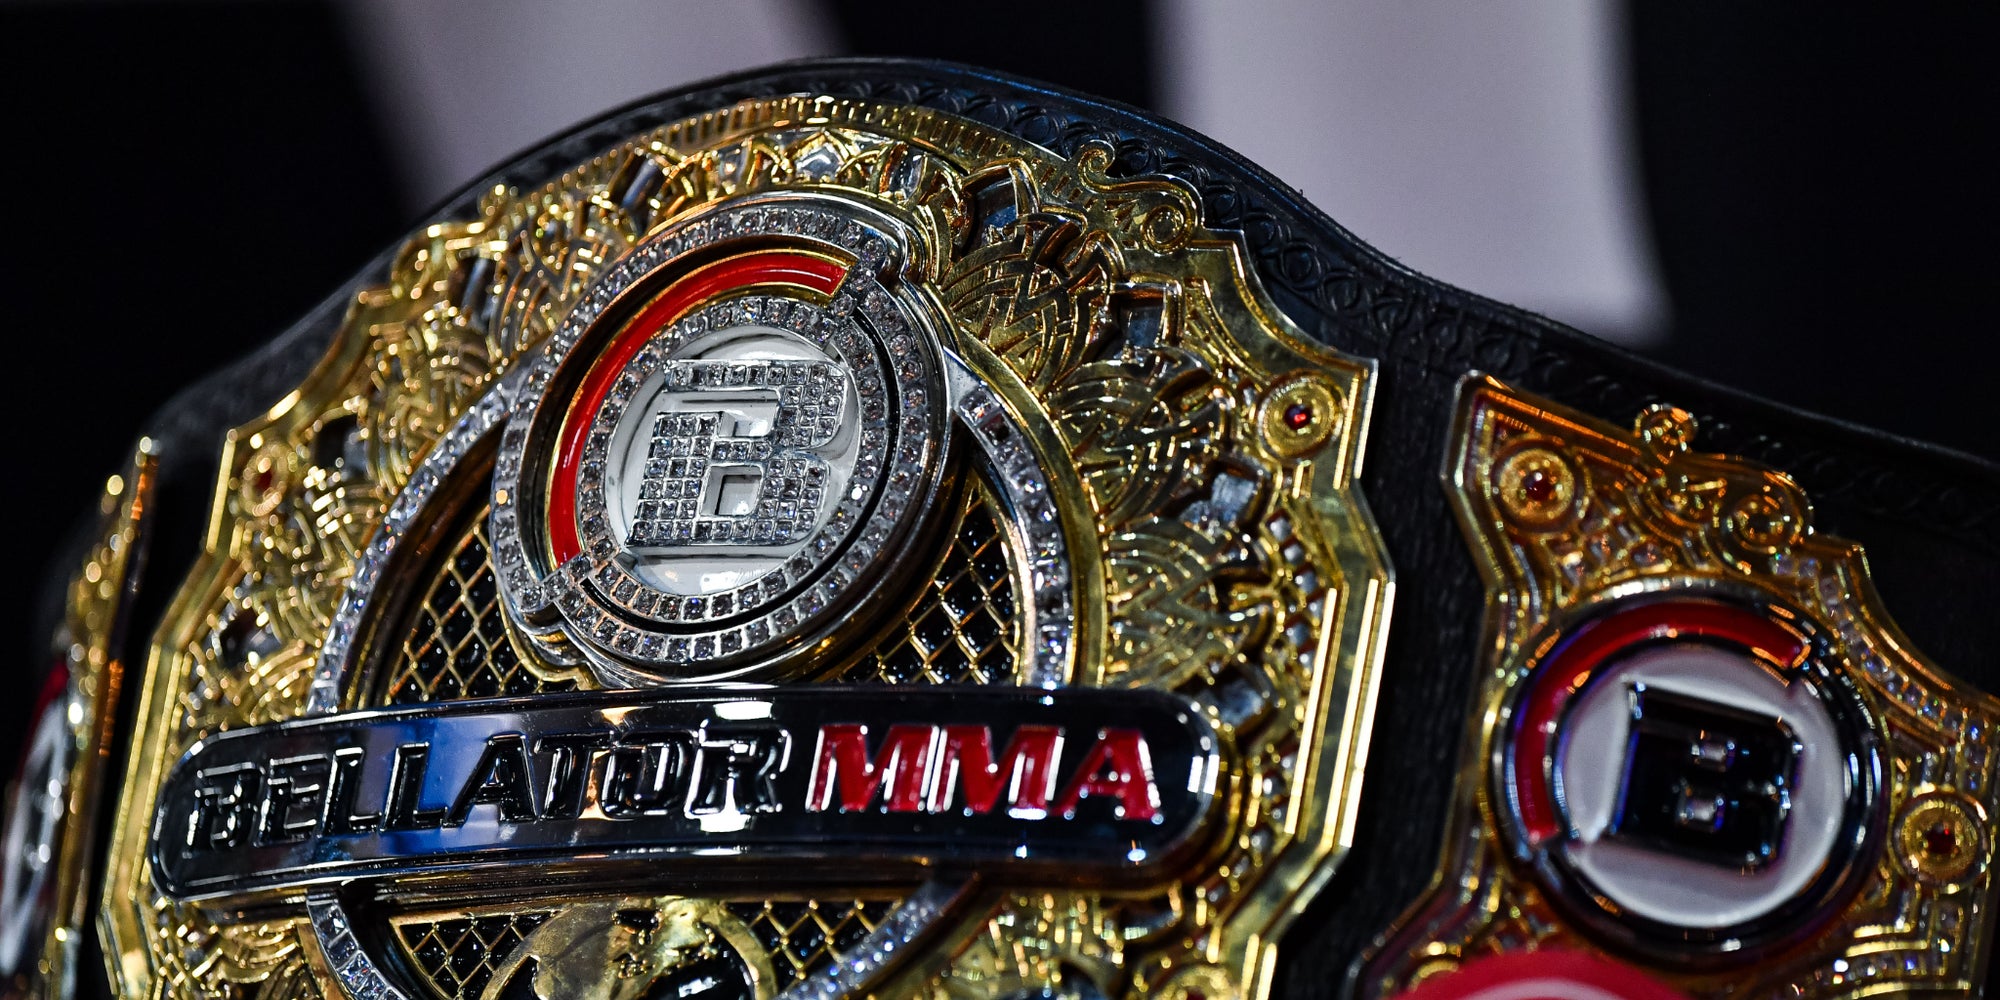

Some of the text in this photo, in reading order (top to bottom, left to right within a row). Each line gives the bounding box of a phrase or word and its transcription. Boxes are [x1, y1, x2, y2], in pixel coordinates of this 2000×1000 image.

[625, 358, 850, 548] B
[185, 721, 790, 854] BELLATOR
[804, 723, 1164, 825] MMA
[1610, 681, 1802, 873] B
